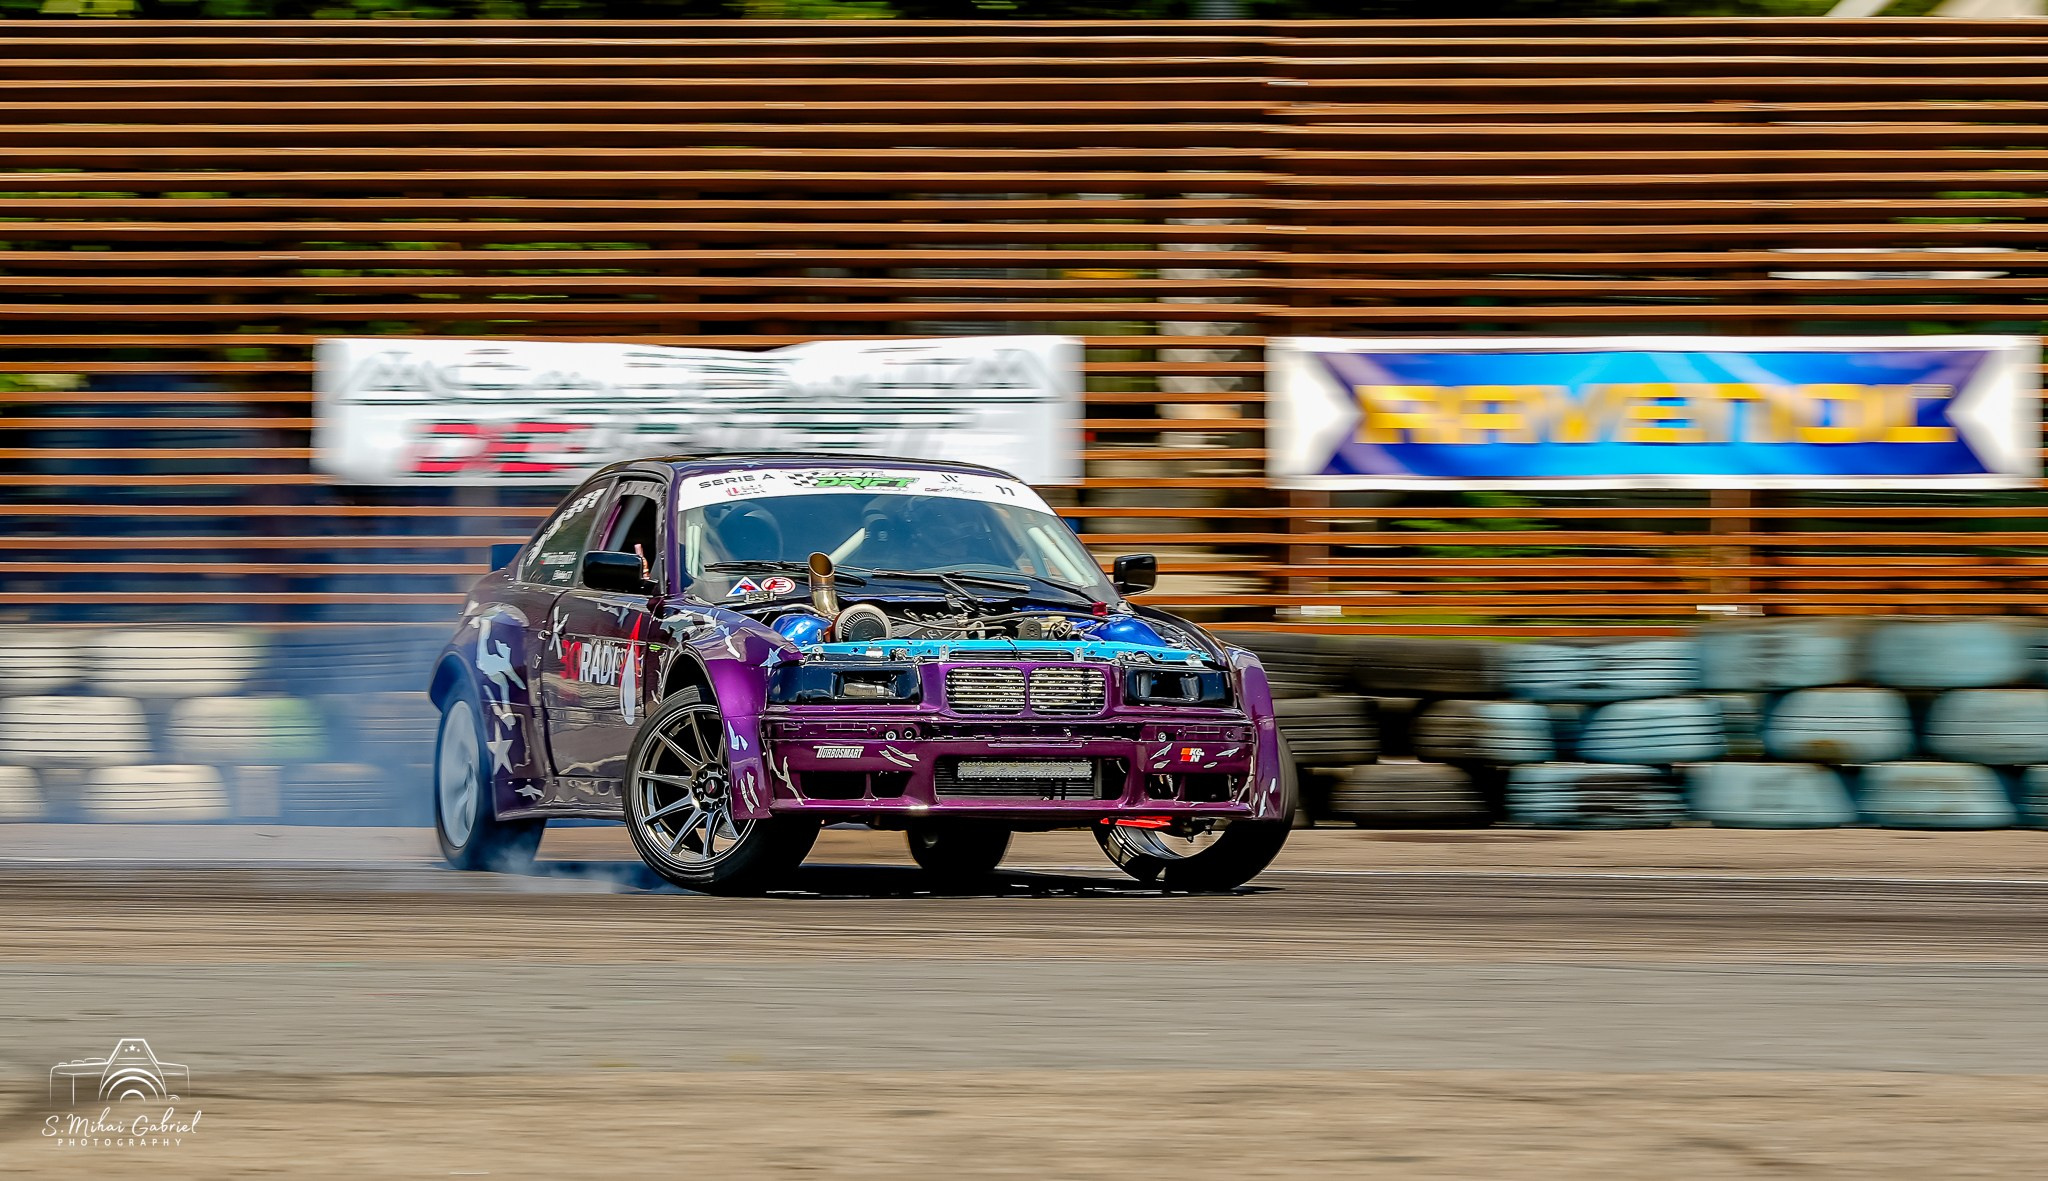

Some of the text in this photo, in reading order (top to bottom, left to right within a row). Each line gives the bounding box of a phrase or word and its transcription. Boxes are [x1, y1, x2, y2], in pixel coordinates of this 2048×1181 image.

[1351, 382, 1957, 444] RAVENOL
[698, 474, 755, 489] SERIE
[815, 476, 914, 490] DRIFT
[813, 745, 865, 759] TURBOSMART
